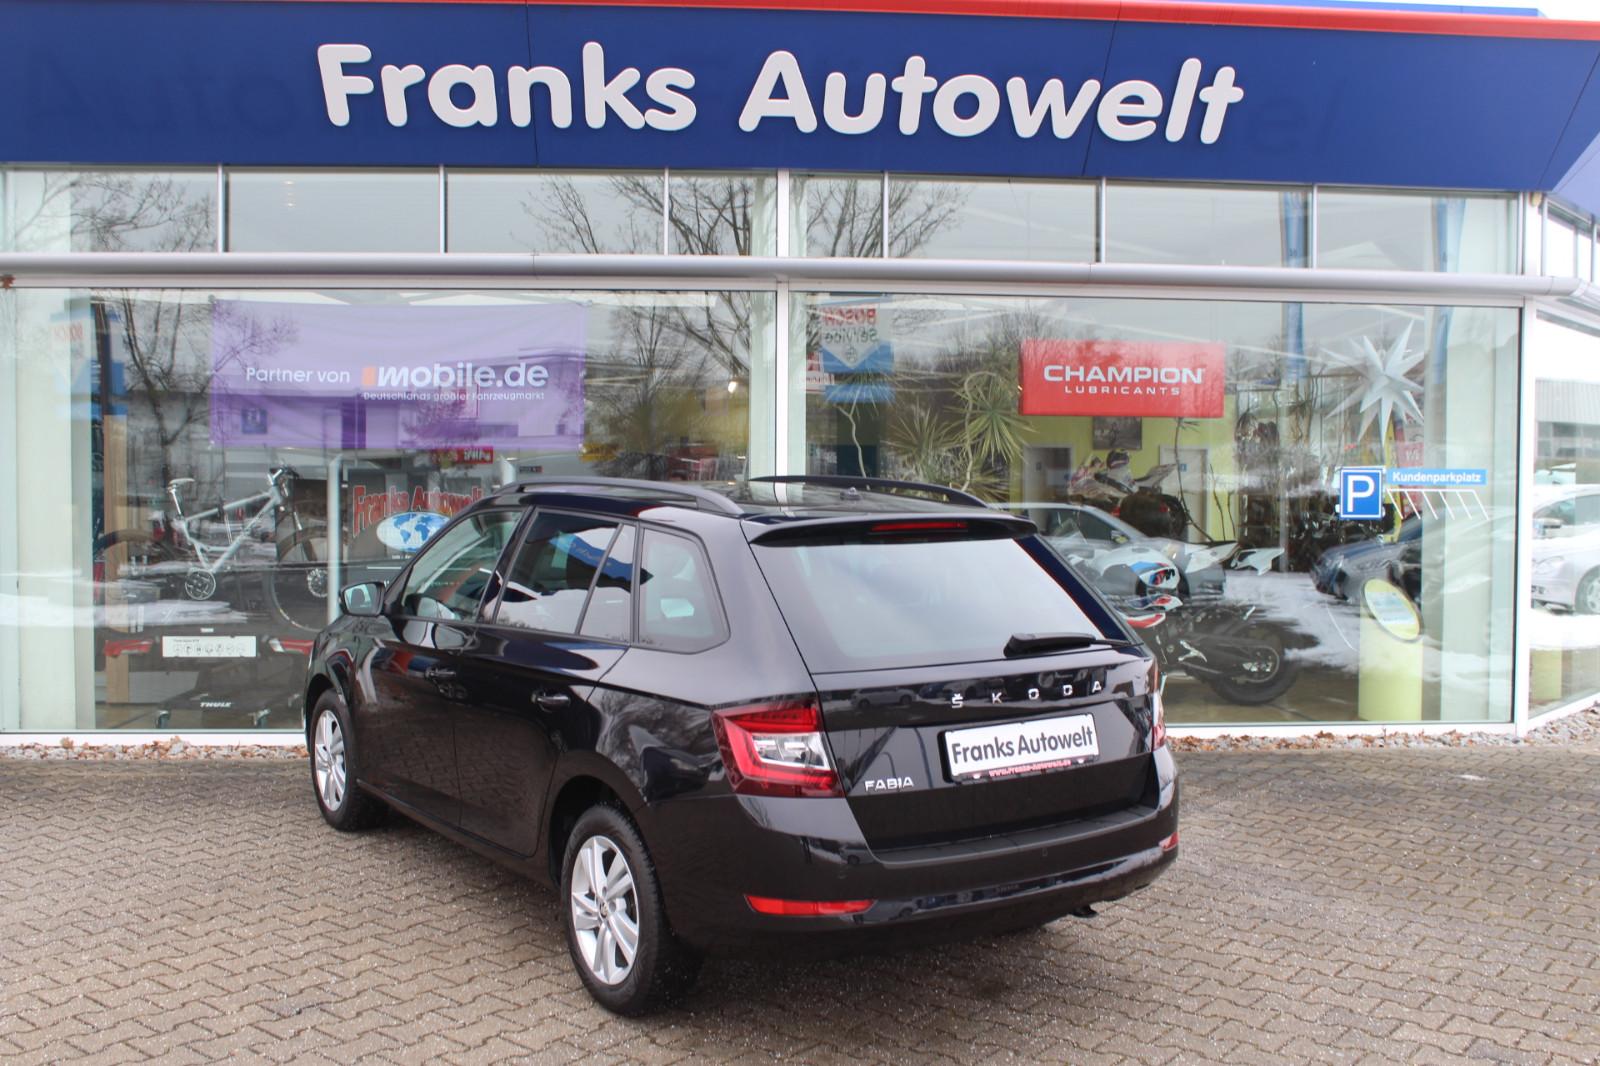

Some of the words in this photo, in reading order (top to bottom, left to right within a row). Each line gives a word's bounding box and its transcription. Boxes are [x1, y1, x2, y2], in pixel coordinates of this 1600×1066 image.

[317, 41, 697, 132] Franks
[739, 50, 1244, 146] Autowelt
[246, 366, 313, 383] Partner
[317, 370, 350, 383] von
[377, 361, 549, 388] mobile.de
[1044, 364, 1203, 384] CHAMPION
[363, 391, 431, 401] Deutschlands
[1064, 385, 1181, 396] LUBRICANTS
[1392, 471, 1482, 484] Kundenparkplatz
[1346, 474, 1375, 512] P
[352, 485, 410, 538] Franks
[411, 485, 484, 518] Autow
[951, 680, 1102, 708] ŠKODA
[951, 736, 1015, 764] Franks
[1018, 725, 1093, 756] Autowelt
[864, 775, 915, 793] FABIA
